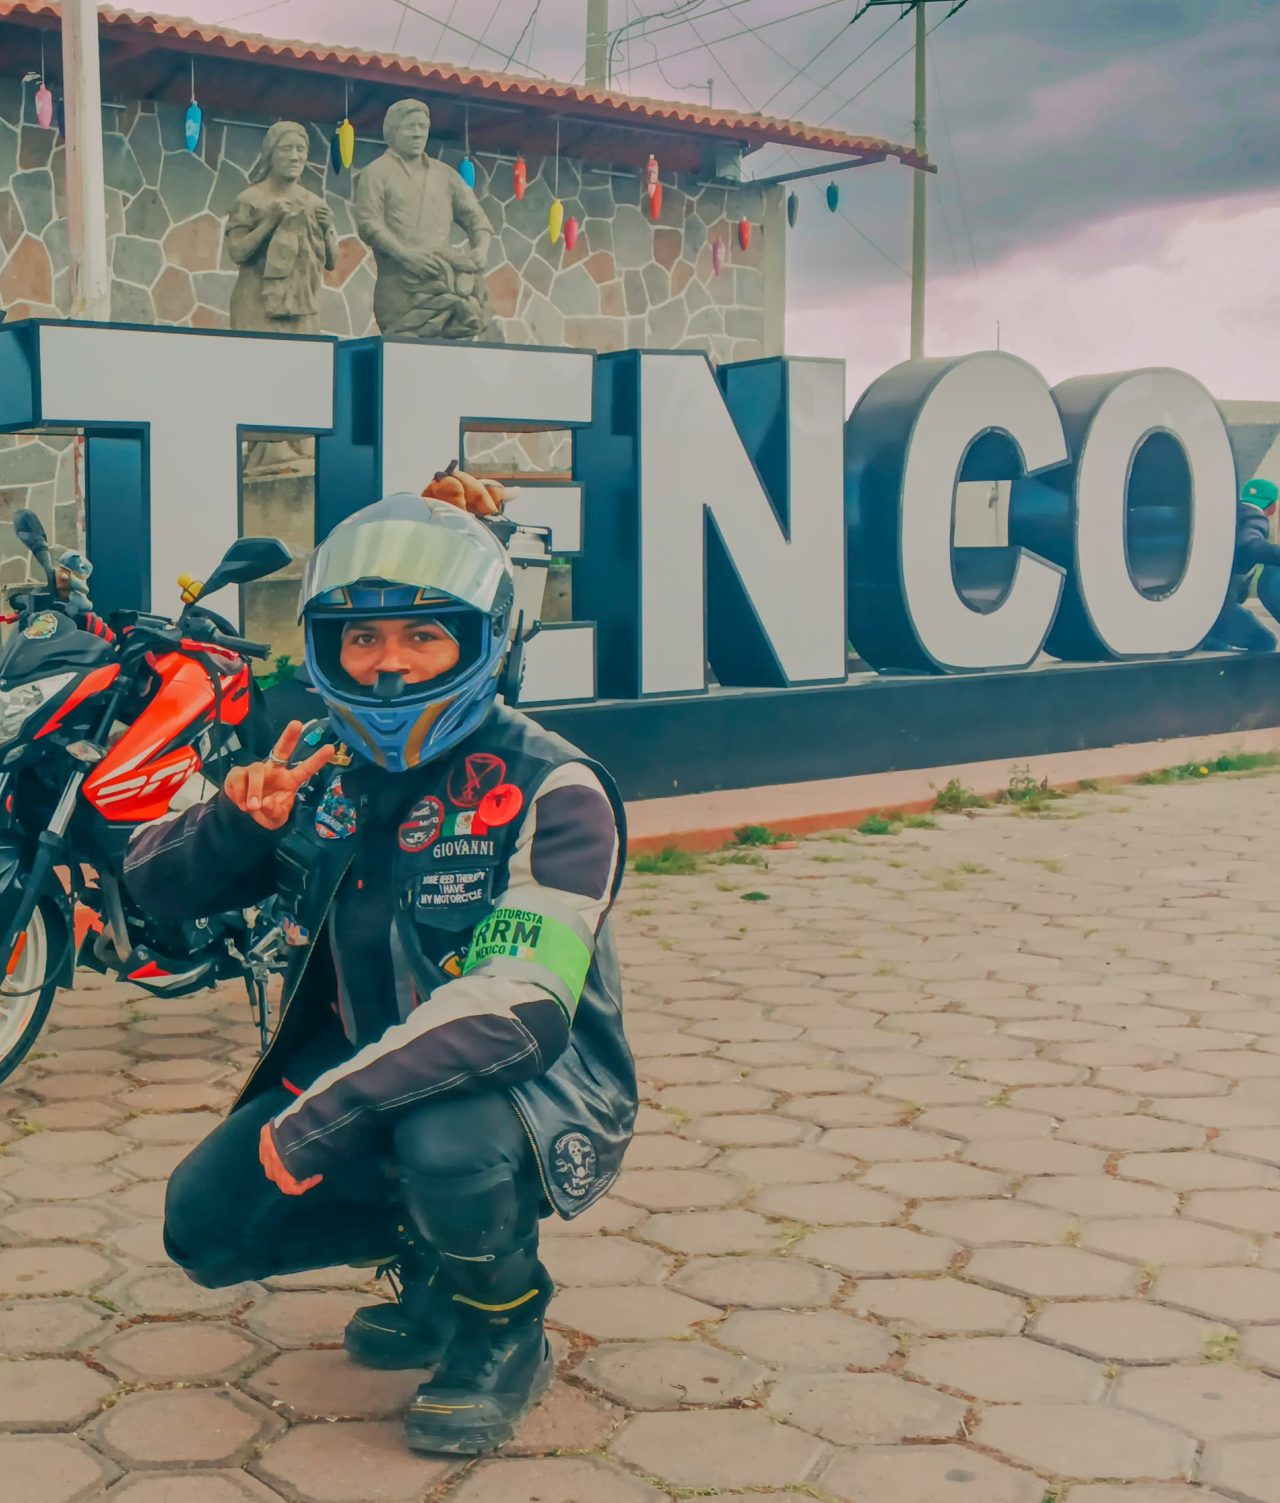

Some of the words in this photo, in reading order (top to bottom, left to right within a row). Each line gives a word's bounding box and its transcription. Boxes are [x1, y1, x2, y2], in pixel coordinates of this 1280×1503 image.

[433, 838, 495, 858] GIOVANNI
[421, 893, 433, 904] MY
[433, 888, 483, 905] MOTORCYCLE
[443, 883, 466, 894] HAVE
[475, 919, 542, 949] RRM
[475, 944, 507, 962] MEXICO
